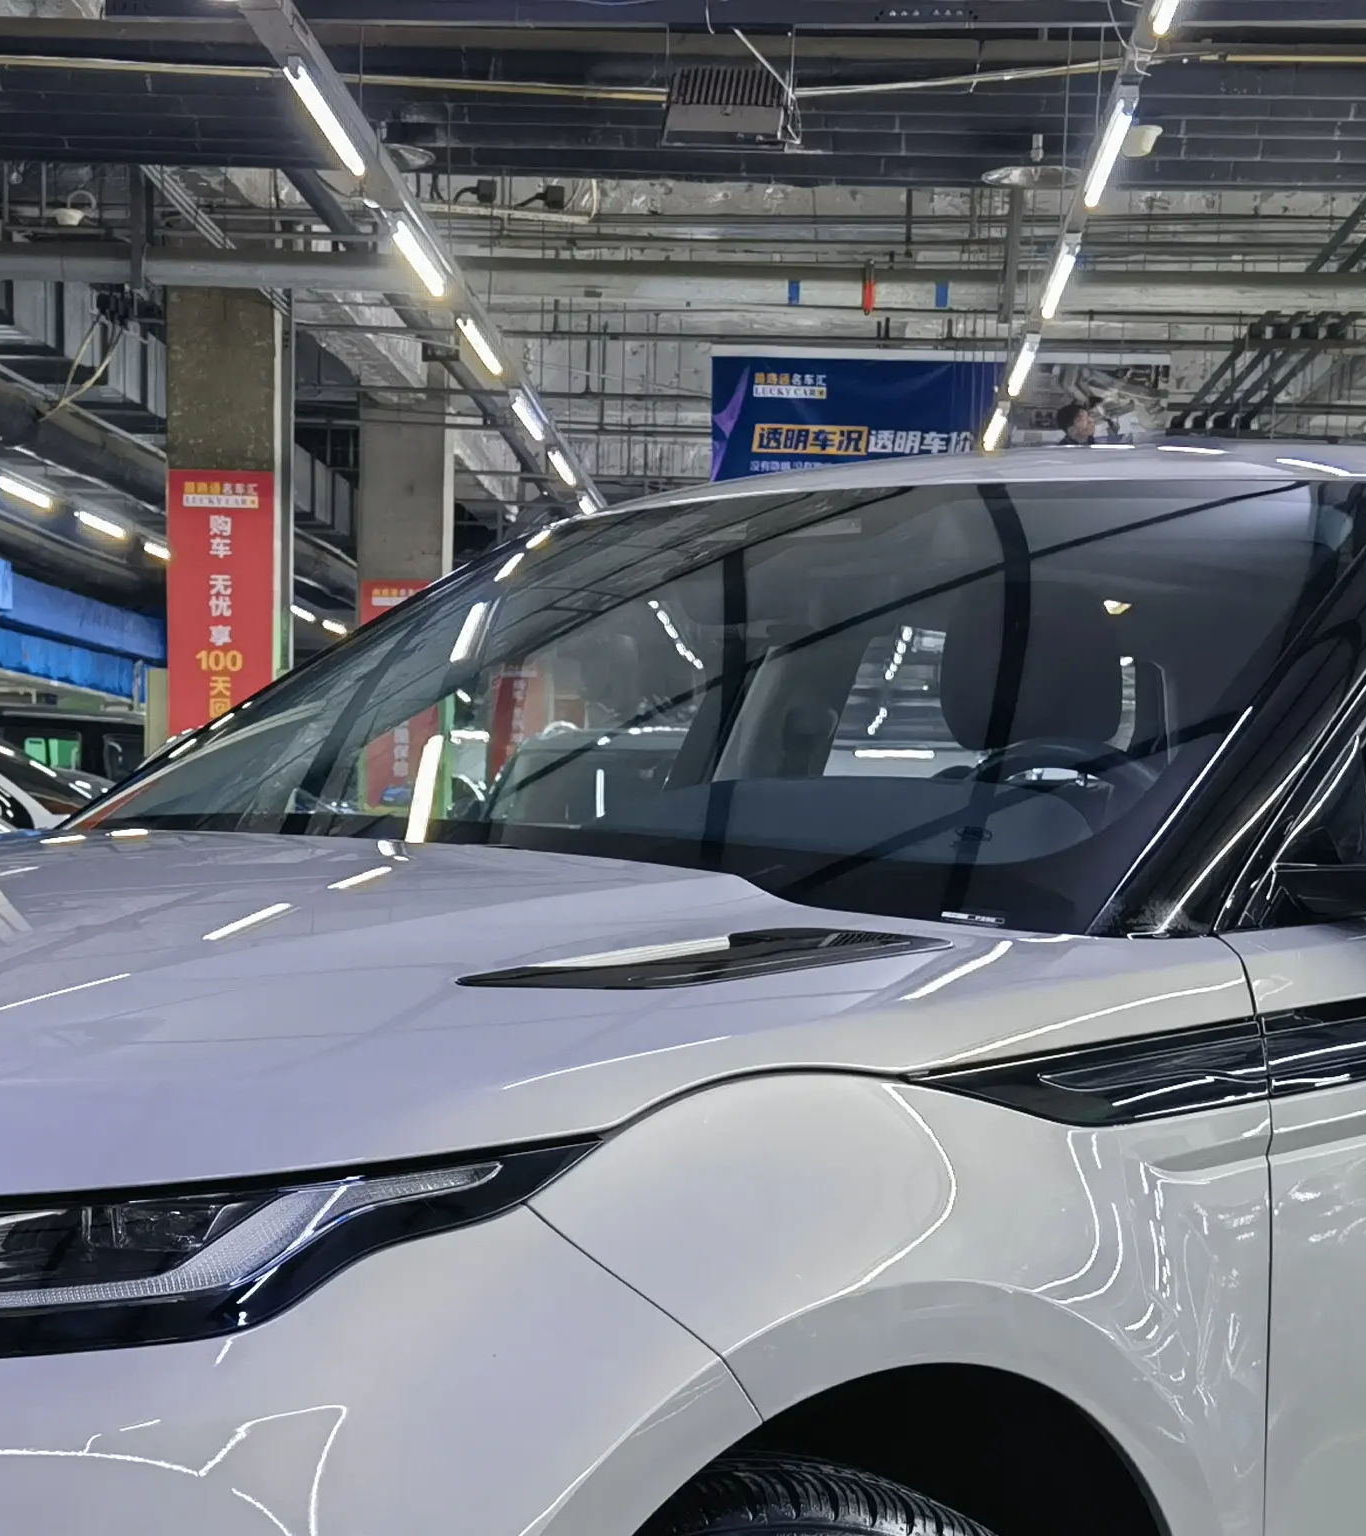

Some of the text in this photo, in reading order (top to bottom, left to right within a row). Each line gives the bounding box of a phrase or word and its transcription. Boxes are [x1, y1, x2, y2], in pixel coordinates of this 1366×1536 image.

[758, 427, 863, 451] 透明车况
[209, 515, 232, 558] 购车
[209, 574, 232, 617] 无忧
